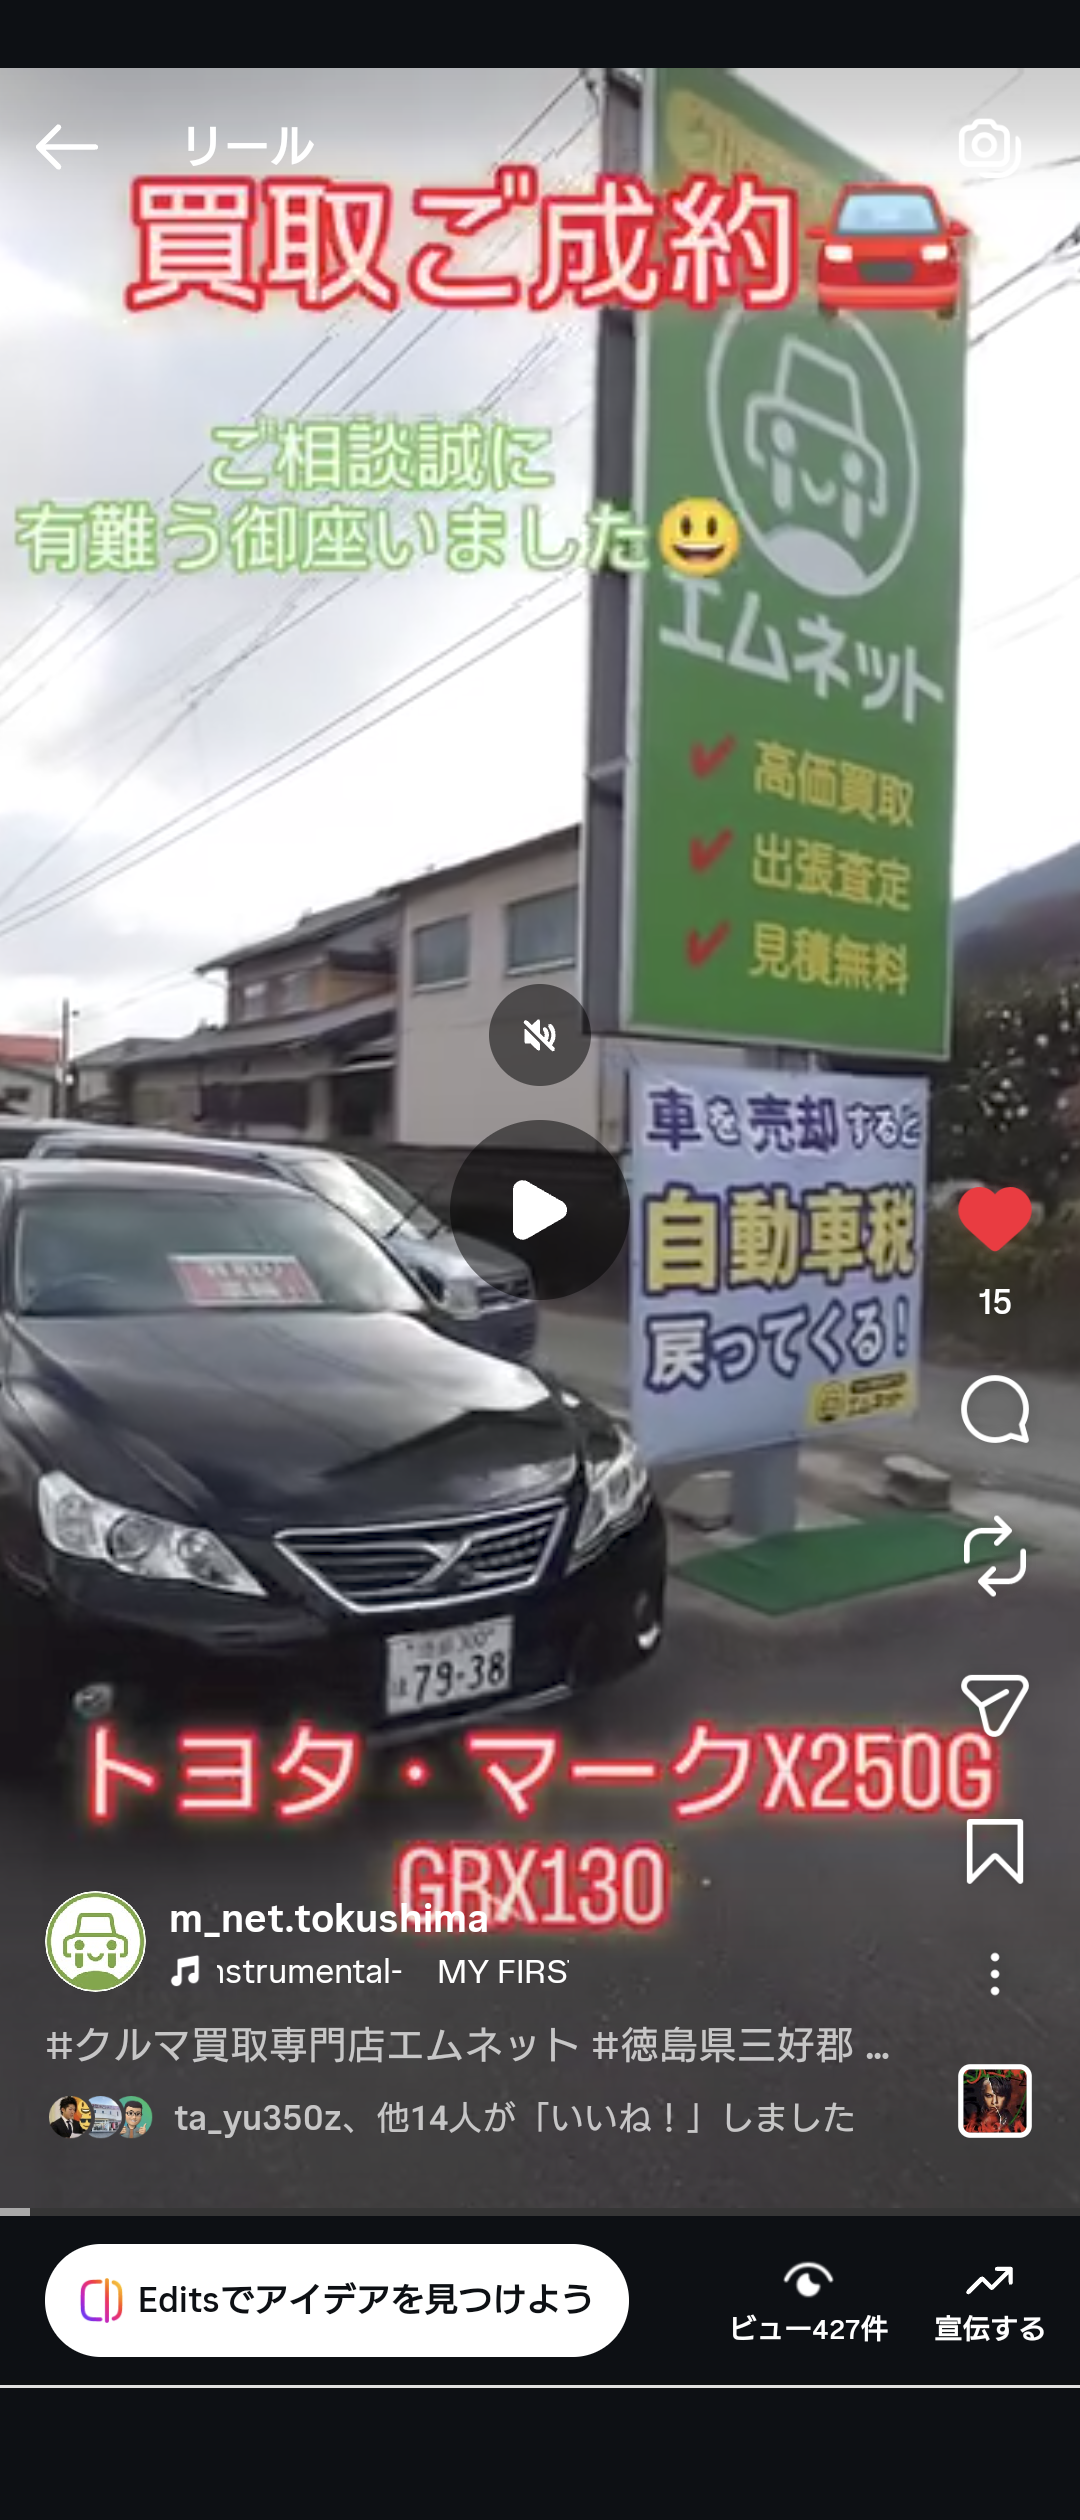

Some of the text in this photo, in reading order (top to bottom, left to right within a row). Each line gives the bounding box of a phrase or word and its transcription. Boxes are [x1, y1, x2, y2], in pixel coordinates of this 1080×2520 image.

[658, 570, 944, 724] エムネット
[752, 739, 914, 828] 高価買取
[752, 830, 912, 911] 出張査定
[748, 922, 908, 996] 見積無料
[645, 1086, 921, 1153] 車を売却すると
[642, 1182, 916, 1297] 自動車税
